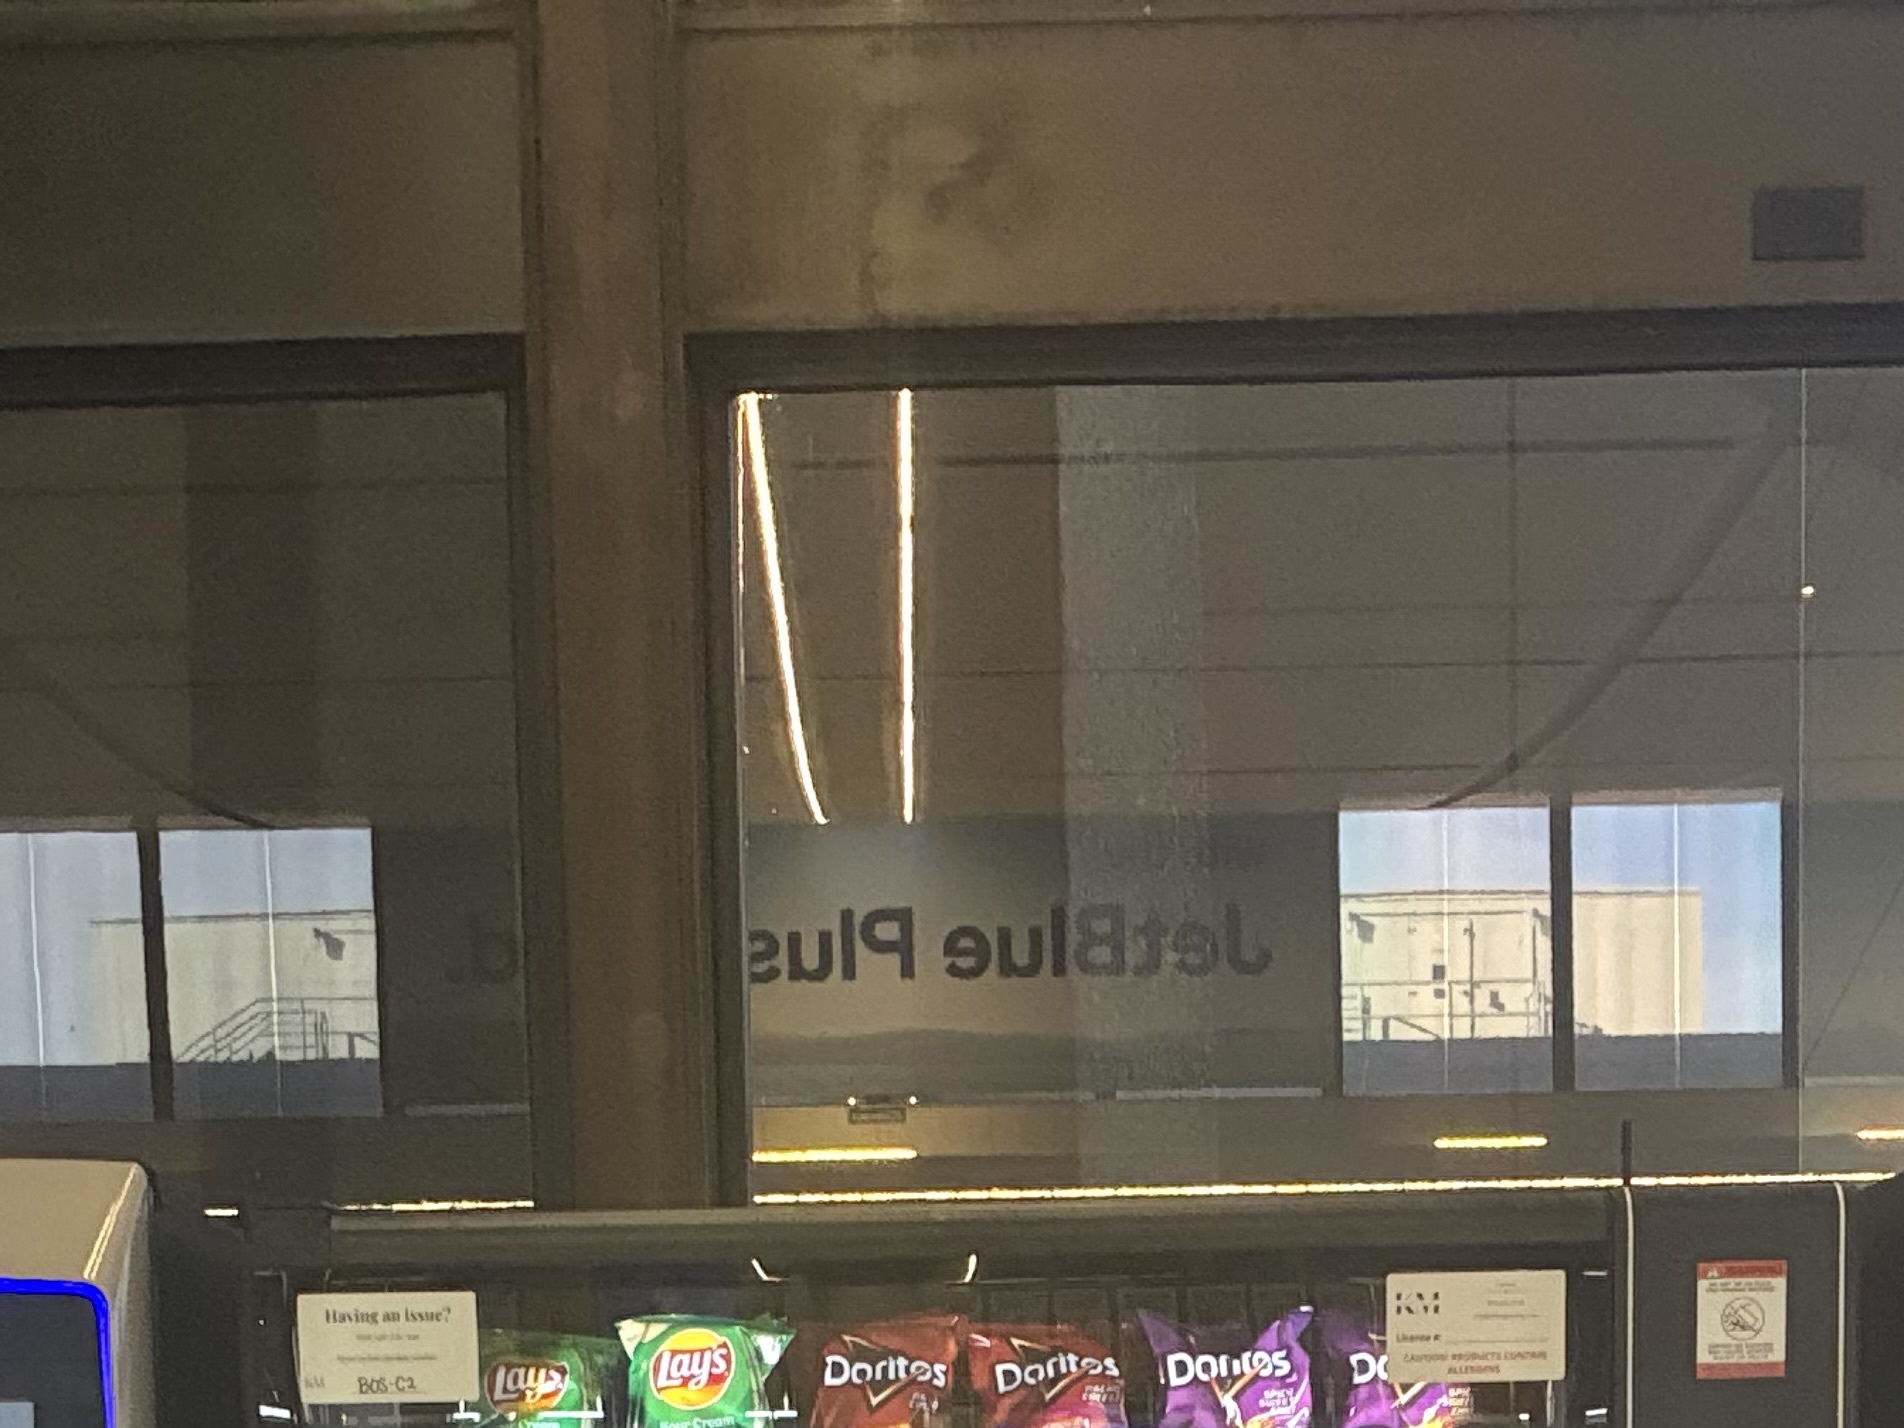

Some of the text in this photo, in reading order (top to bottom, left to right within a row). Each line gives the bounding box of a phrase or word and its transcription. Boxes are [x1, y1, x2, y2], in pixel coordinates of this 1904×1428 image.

[325, 1308, 378, 1327] Having
[381, 1311, 400, 1323] an
[658, 1344, 730, 1391] Lay's
[824, 1352, 947, 1389] Doritos
[995, 1350, 1120, 1393] Doritos
[1166, 1347, 1291, 1387] Doritos
